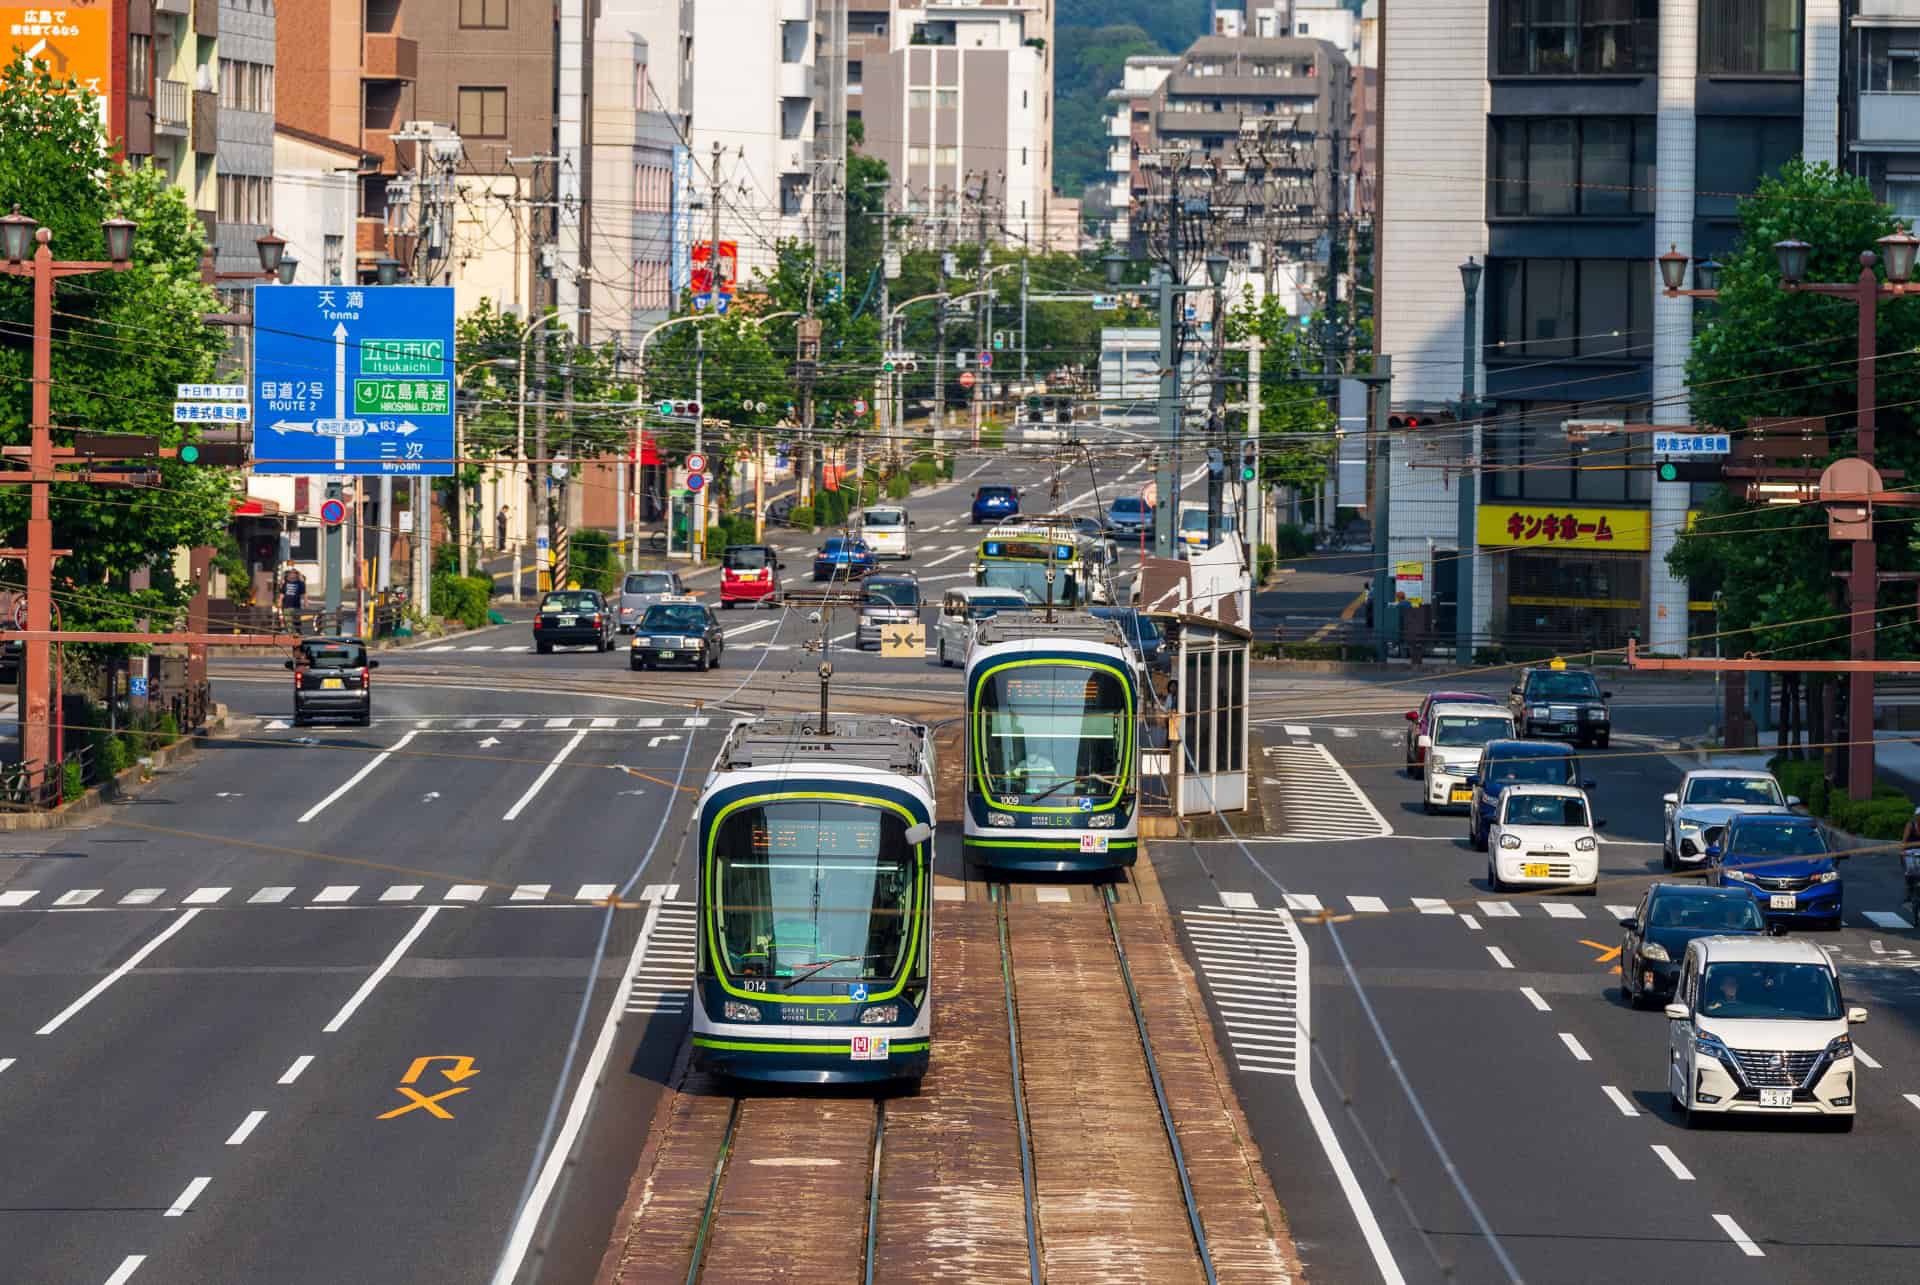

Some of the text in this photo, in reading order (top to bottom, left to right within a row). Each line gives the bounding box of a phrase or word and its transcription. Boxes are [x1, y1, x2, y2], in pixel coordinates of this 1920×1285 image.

[318, 290, 364, 309] 天満
[322, 310, 360, 321] Tenma
[364, 342, 441, 361] 五日市IC
[373, 362, 431, 372] Itsukaichi
[261, 382, 325, 400] 国道2号
[363, 386, 372, 398] 4
[382, 383, 446, 401] 広島高速
[269, 401, 316, 411] ROUTE 2
[380, 420, 396, 431] 183
[380, 442, 424, 459] 三次
[1507, 511, 1614, 542] キンキホーム
[1000, 795, 1019, 805] 1009
[1049, 816, 1072, 826] LEX
[743, 981, 767, 993] 1014
[806, 1008, 838, 1021] LEX
